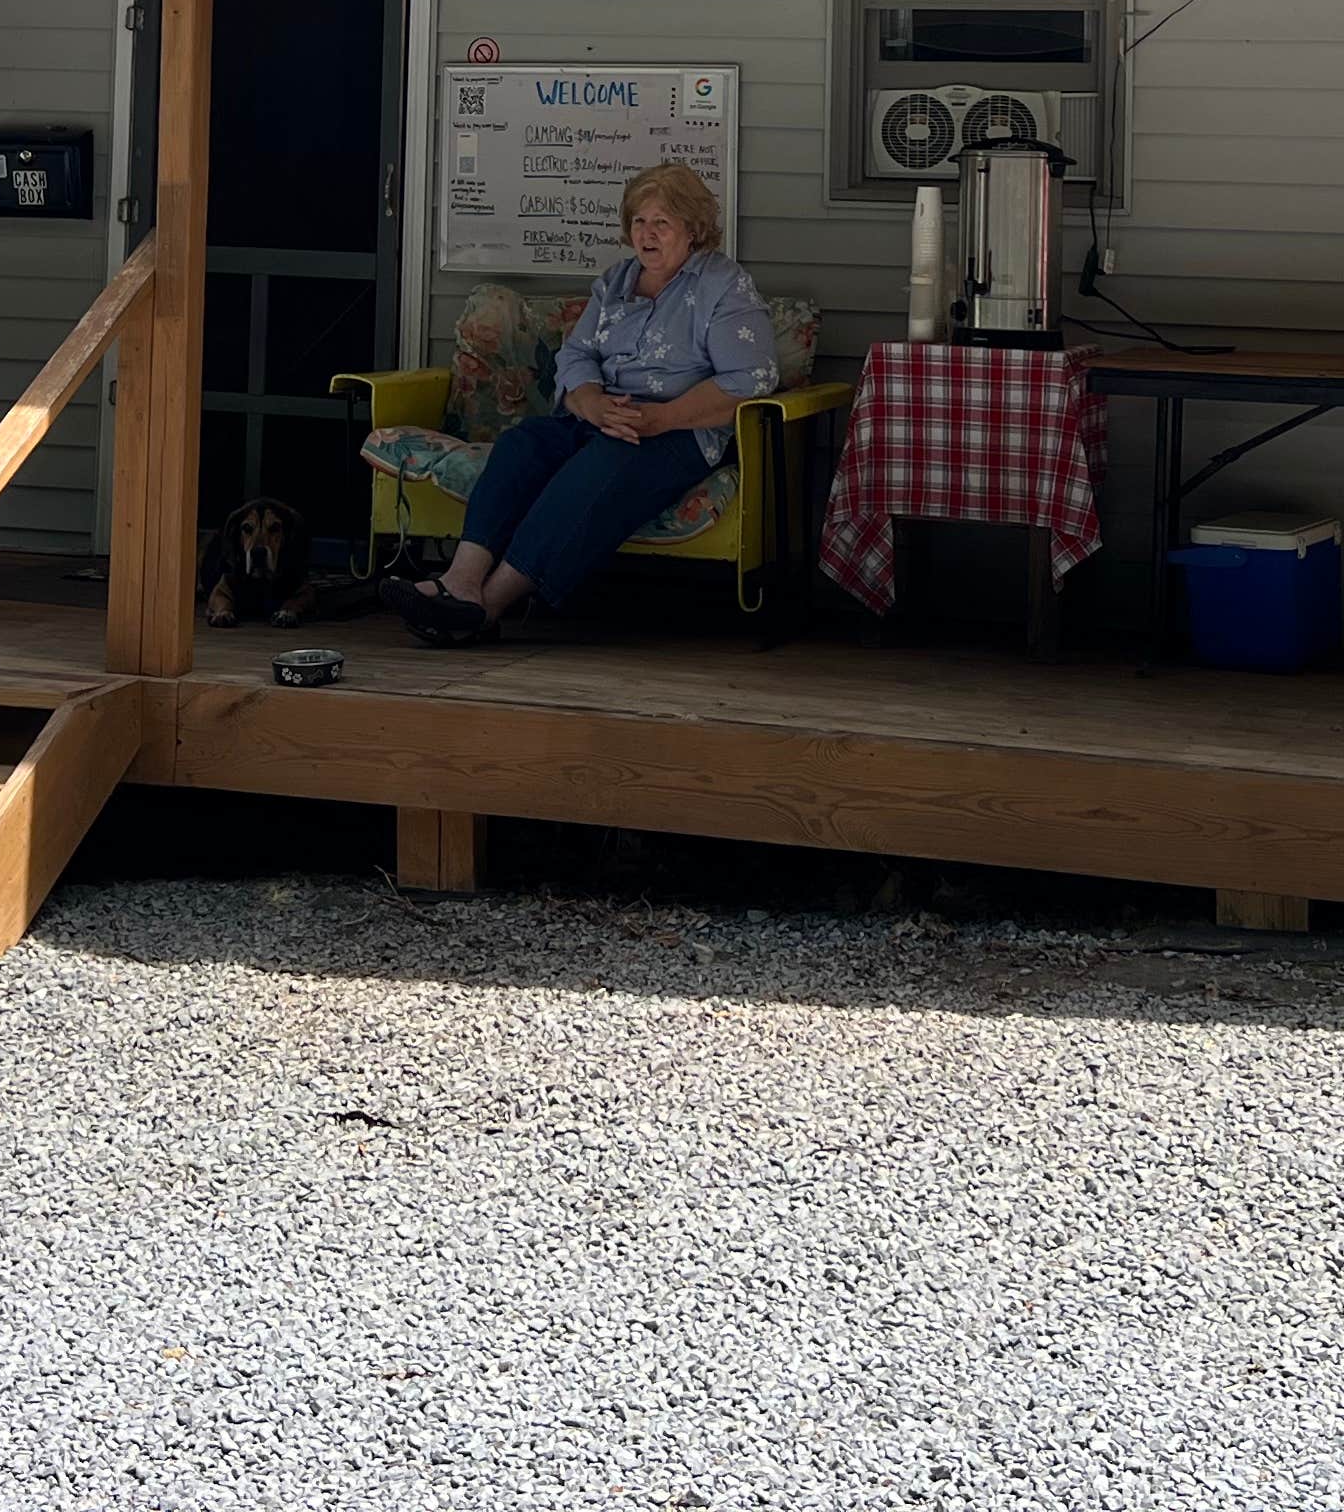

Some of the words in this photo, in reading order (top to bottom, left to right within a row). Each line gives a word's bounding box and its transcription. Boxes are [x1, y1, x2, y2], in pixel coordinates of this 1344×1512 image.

[536, 79, 640, 107] WELCOME
[14, 172, 46, 188] CASH
[20, 189, 43, 204] BOX
